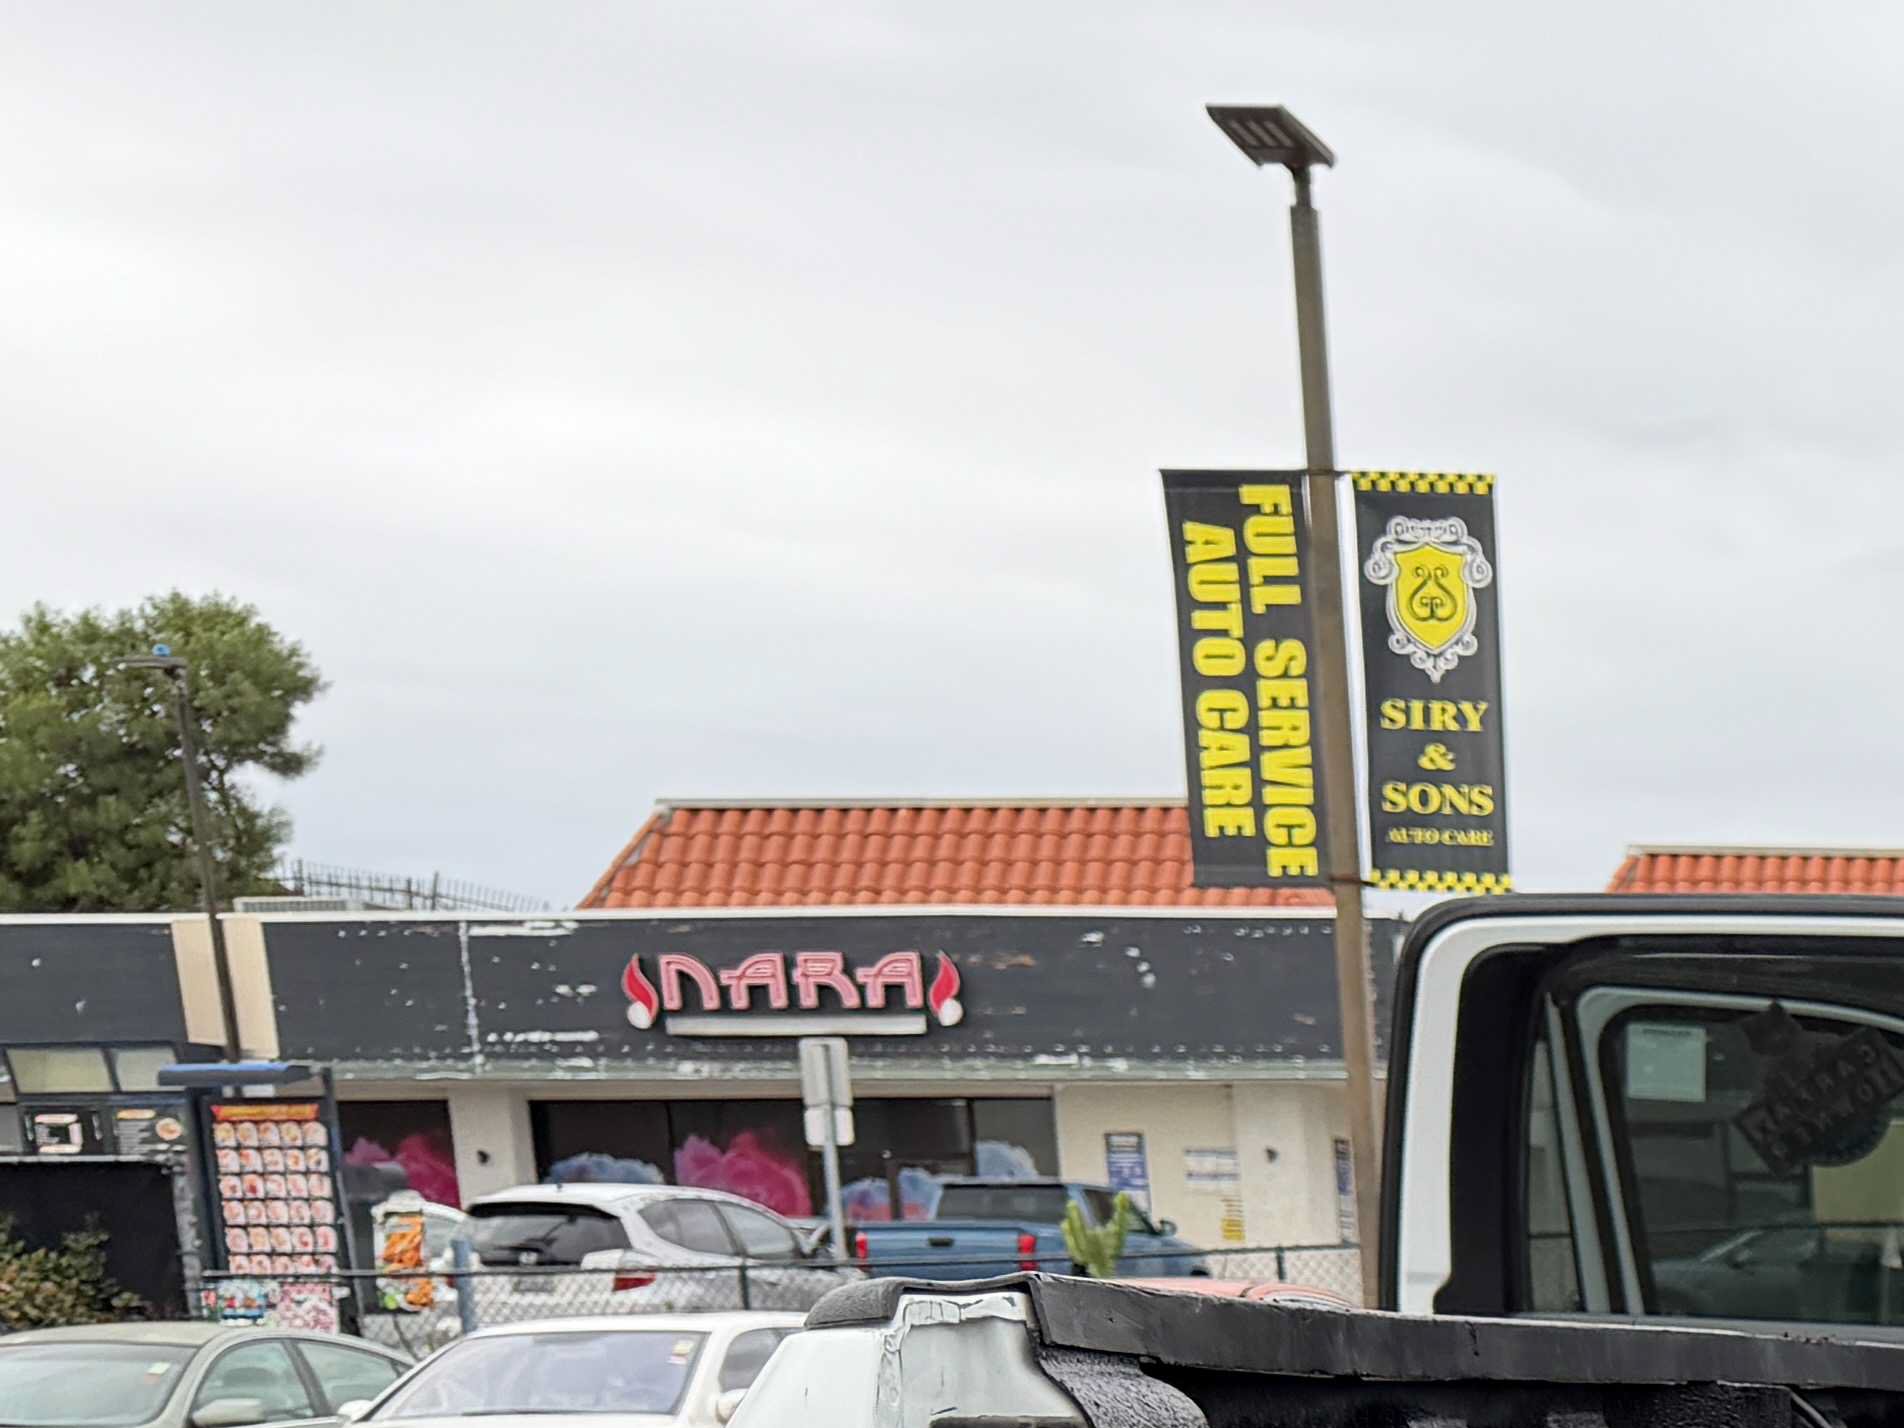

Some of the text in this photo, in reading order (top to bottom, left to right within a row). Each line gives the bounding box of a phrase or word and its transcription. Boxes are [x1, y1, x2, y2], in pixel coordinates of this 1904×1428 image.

[1183, 521, 1256, 838] AUTO CARE
[1239, 484, 1318, 877] FULL SERVICE
[1380, 698, 1489, 732] SIRY
[1417, 743, 1456, 771] &
[1382, 783, 1496, 816] SONS
[1386, 826, 1494, 847] AUTO CARE
[657, 950, 923, 1011] NARA
